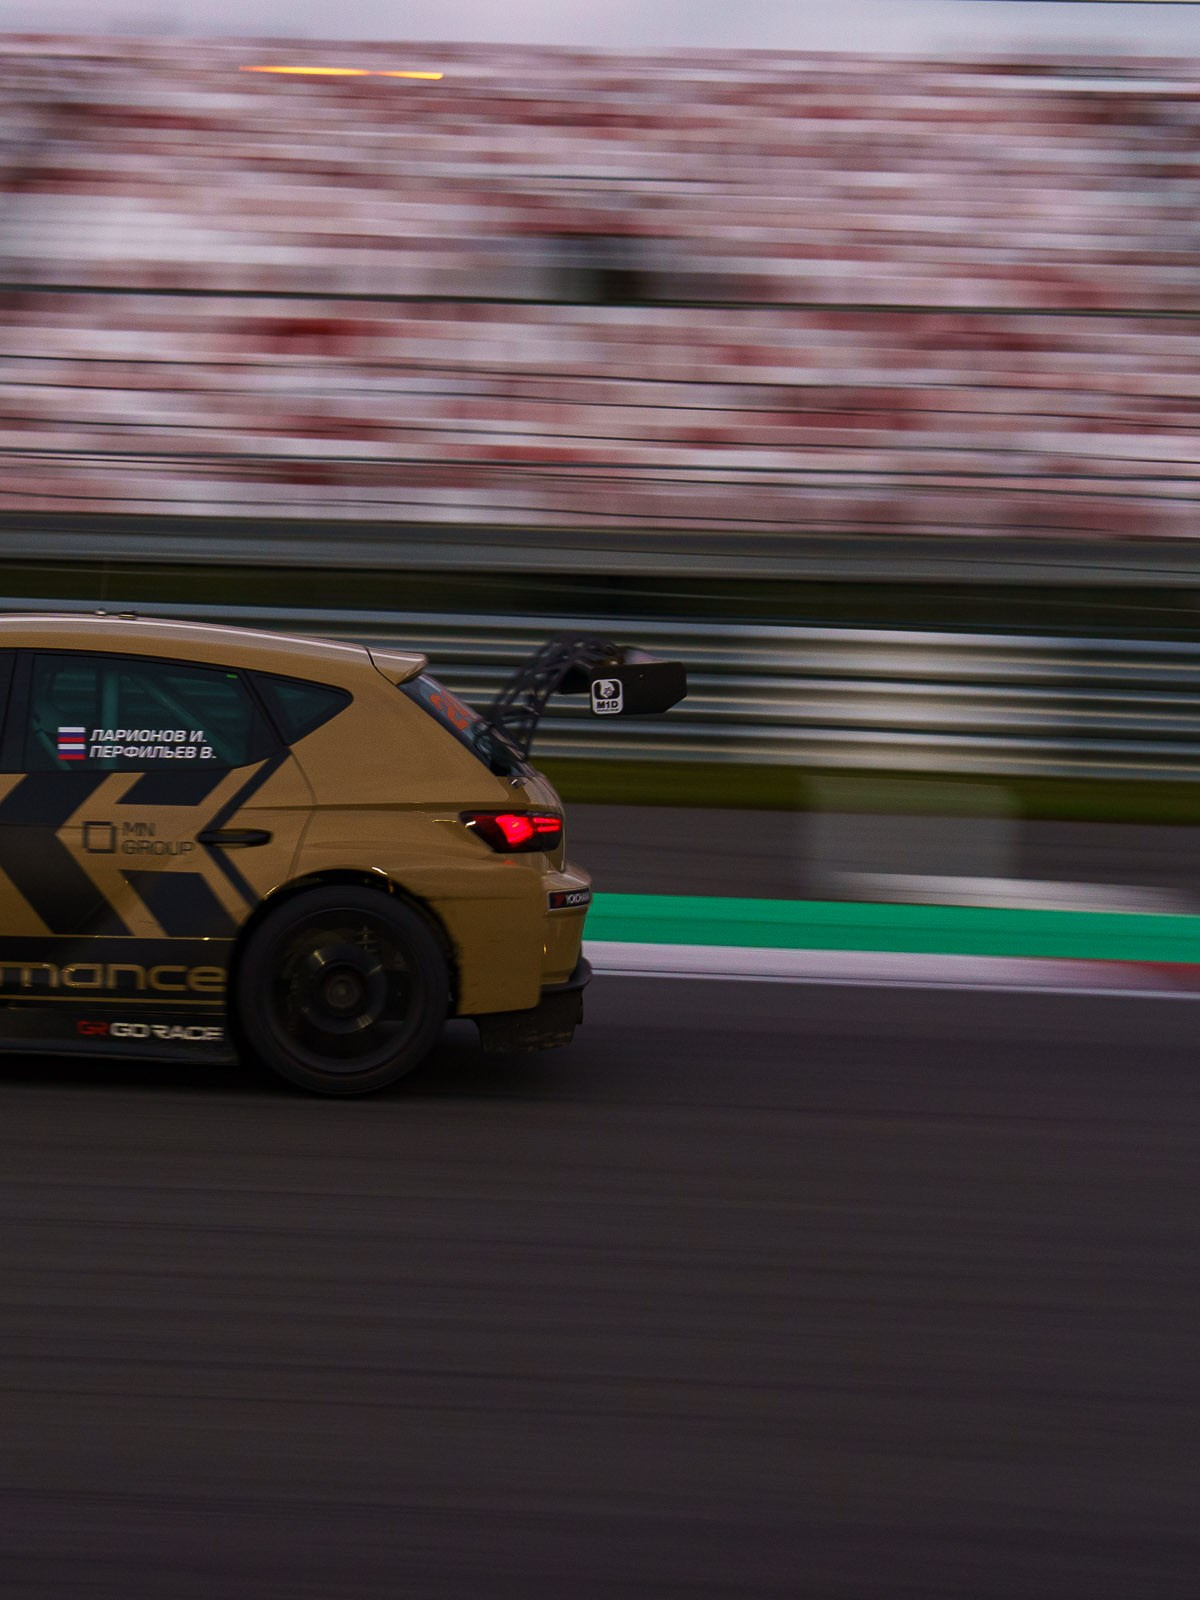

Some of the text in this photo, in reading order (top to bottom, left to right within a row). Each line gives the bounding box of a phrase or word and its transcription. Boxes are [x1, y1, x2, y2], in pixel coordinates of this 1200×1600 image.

[89, 729, 207, 742] ЛАРИОНОВ И.
[89, 745, 216, 759] ПЕРФИЛЬЕВ В.
[122, 839, 195, 855] GROUP
